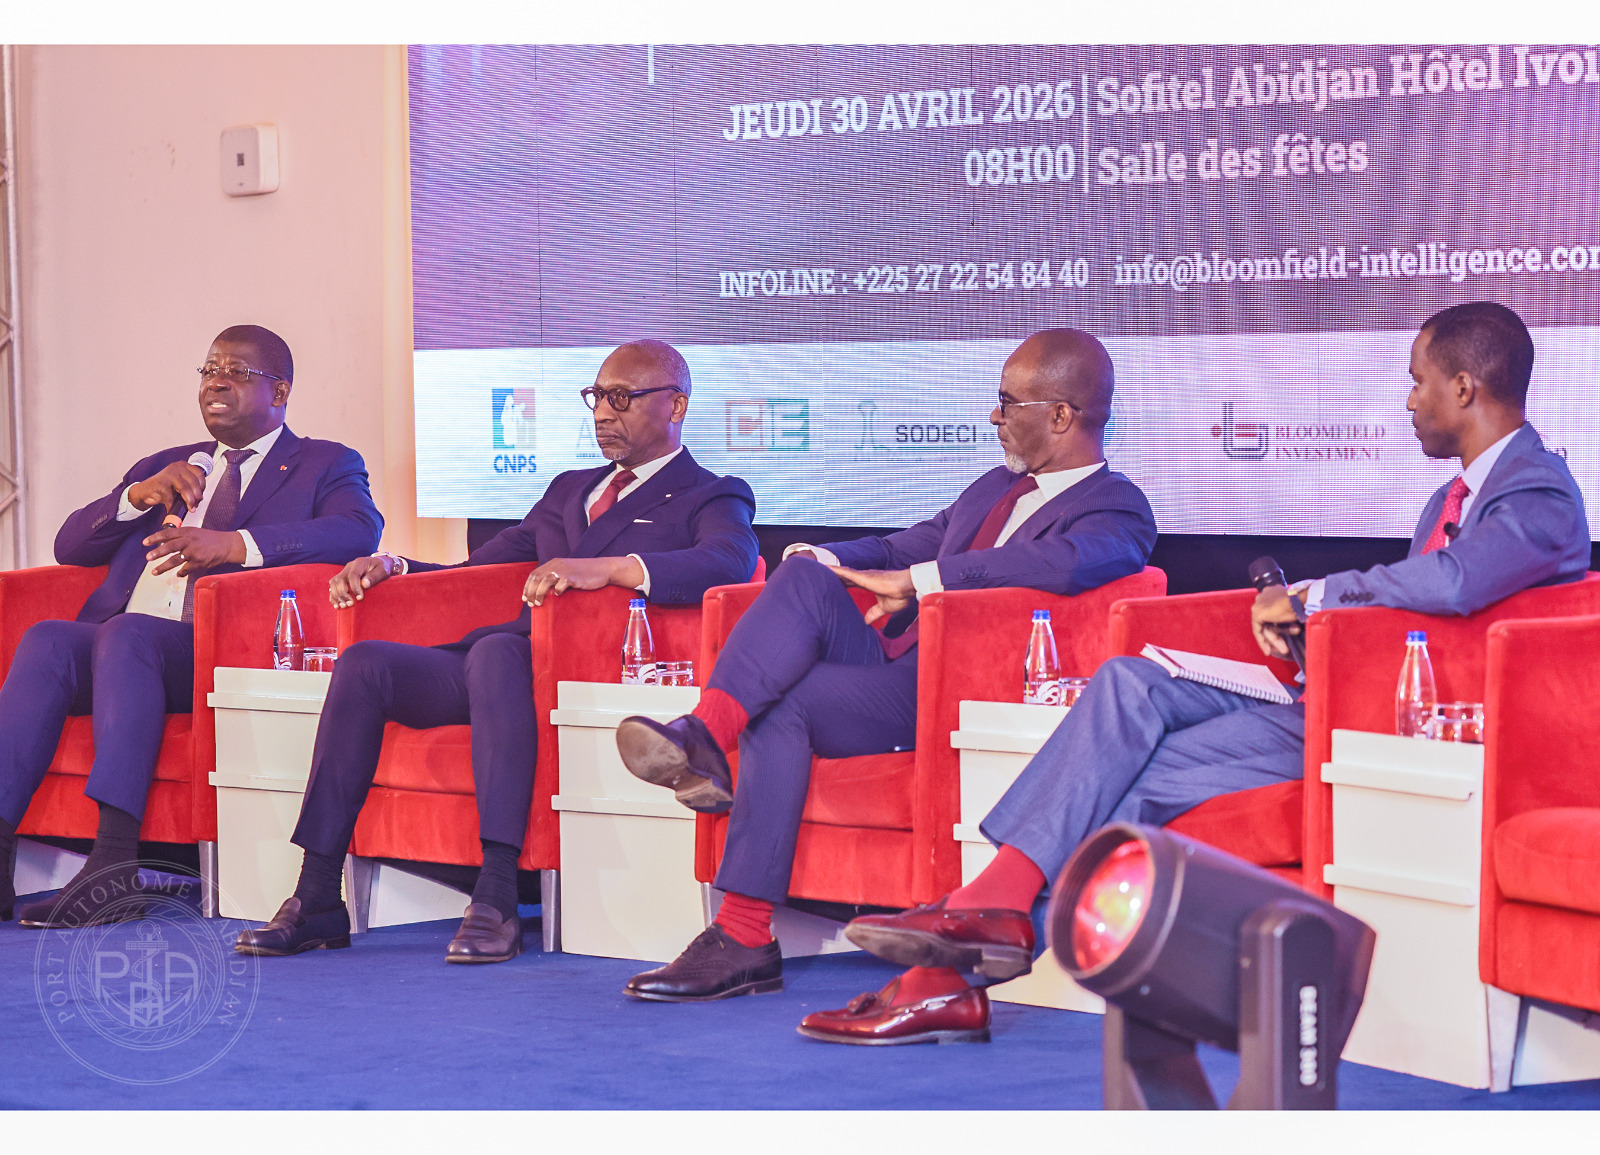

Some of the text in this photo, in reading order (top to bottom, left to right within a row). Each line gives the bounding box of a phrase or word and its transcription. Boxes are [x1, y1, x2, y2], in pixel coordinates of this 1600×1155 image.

[1097, 66, 1216, 116] Sofitel
[1223, 58, 1380, 111] Abidjan
[1390, 47, 1502, 97] Hôtel
[722, 80, 1075, 141] JEUDI 30 AVRIL 2026
[964, 143, 1076, 187] 08H00
[1098, 132, 1368, 185] Salle des fêtes
[718, 268, 836, 298] INFOLINE
[853, 265, 909, 293] +225
[915, 263, 943, 292] 27
[949, 262, 979, 291] 22
[985, 261, 1015, 290] 54
[1021, 260, 1051, 289] 84
[1057, 258, 1089, 288] 40
[895, 424, 977, 443] SODECI
[1275, 425, 1386, 440] BLOOMFIELD
[1275, 447, 1383, 460] INVESTMENT
[493, 454, 537, 473] CNPS
[1299, 985, 1317, 1046] BEAM
